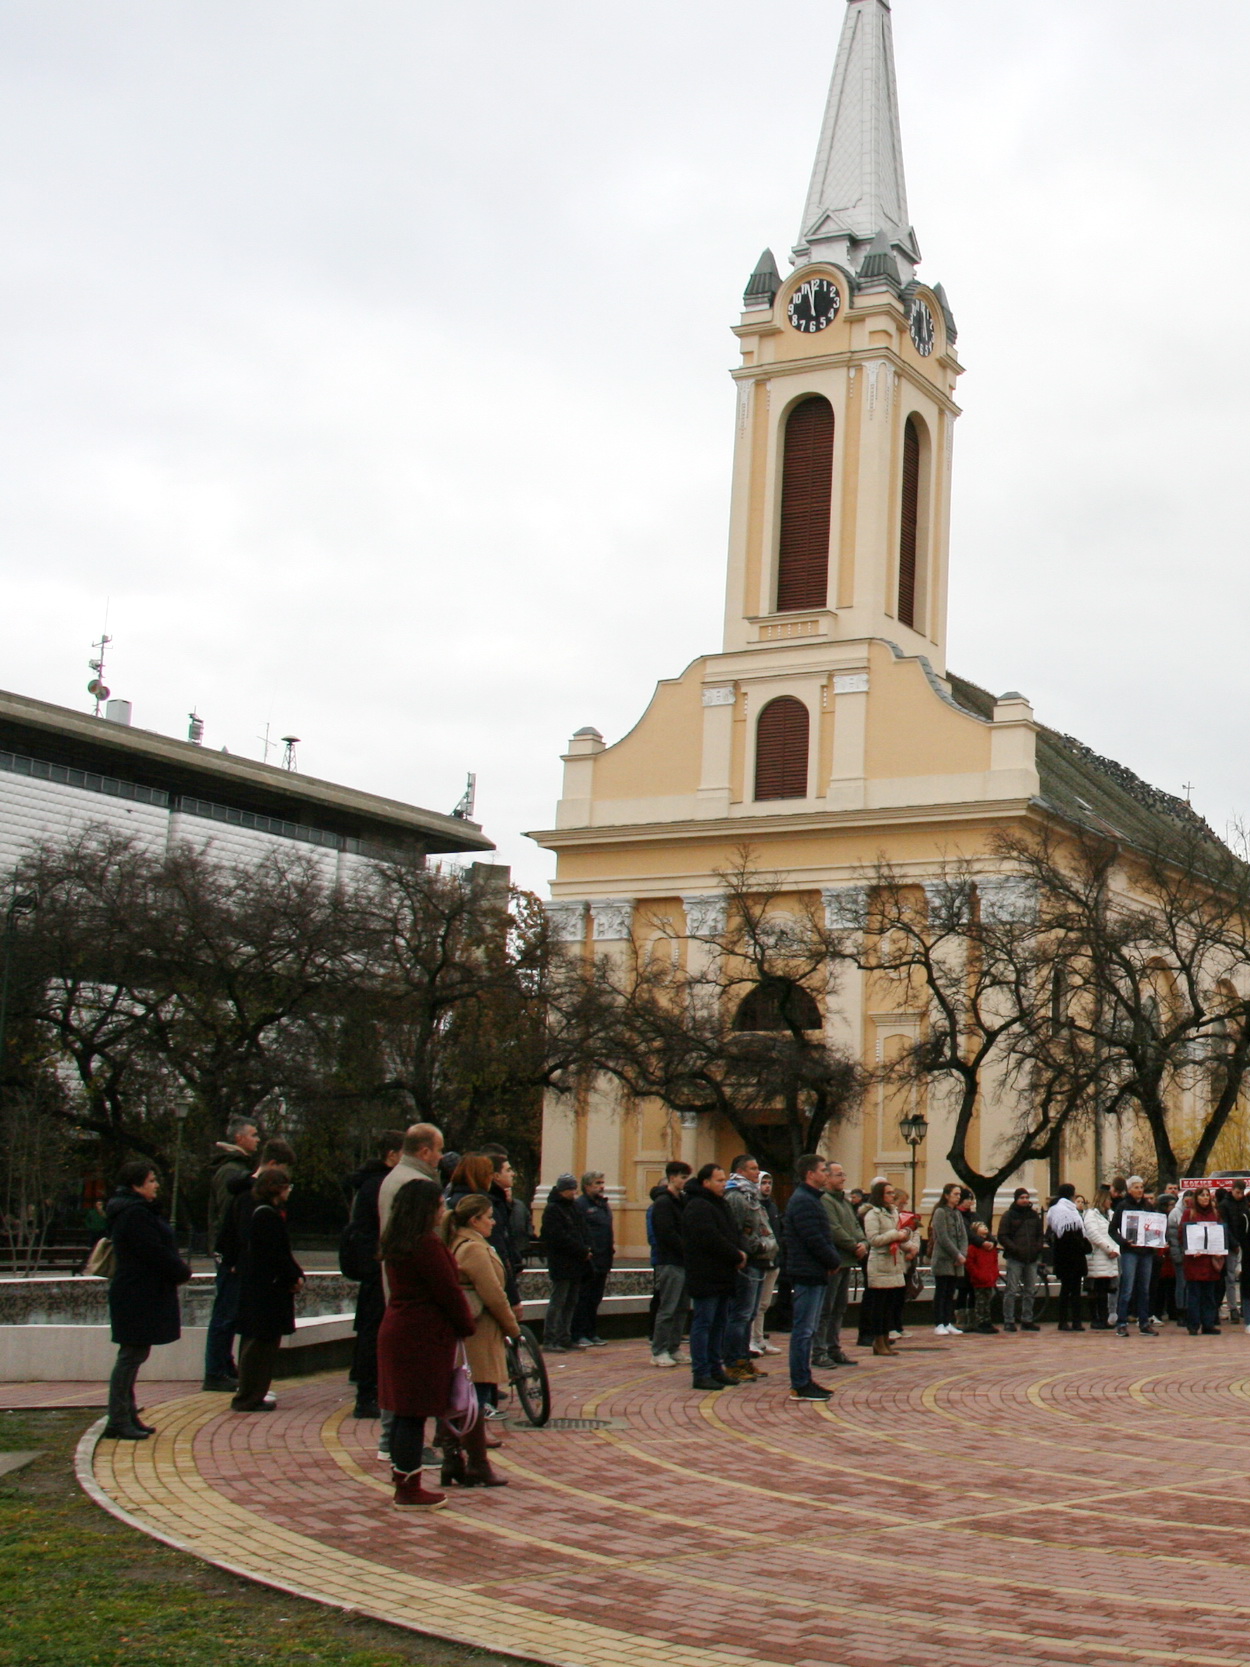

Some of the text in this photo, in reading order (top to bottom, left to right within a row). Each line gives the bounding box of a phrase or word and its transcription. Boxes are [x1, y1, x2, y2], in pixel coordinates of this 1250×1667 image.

[801, 283, 809, 295] 11
[811, 279, 820, 290] 12
[823, 280, 827, 292] 1
[830, 286, 836, 297] 2
[792, 292, 802, 304] 10
[833, 297, 840, 308] 3
[787, 304, 794, 315] 9
[828, 308, 834, 320] 4
[791, 314, 798, 326] 8
[799, 319, 806, 332] 7
[820, 316, 826, 329] 5
[810, 320, 816, 333] 6
